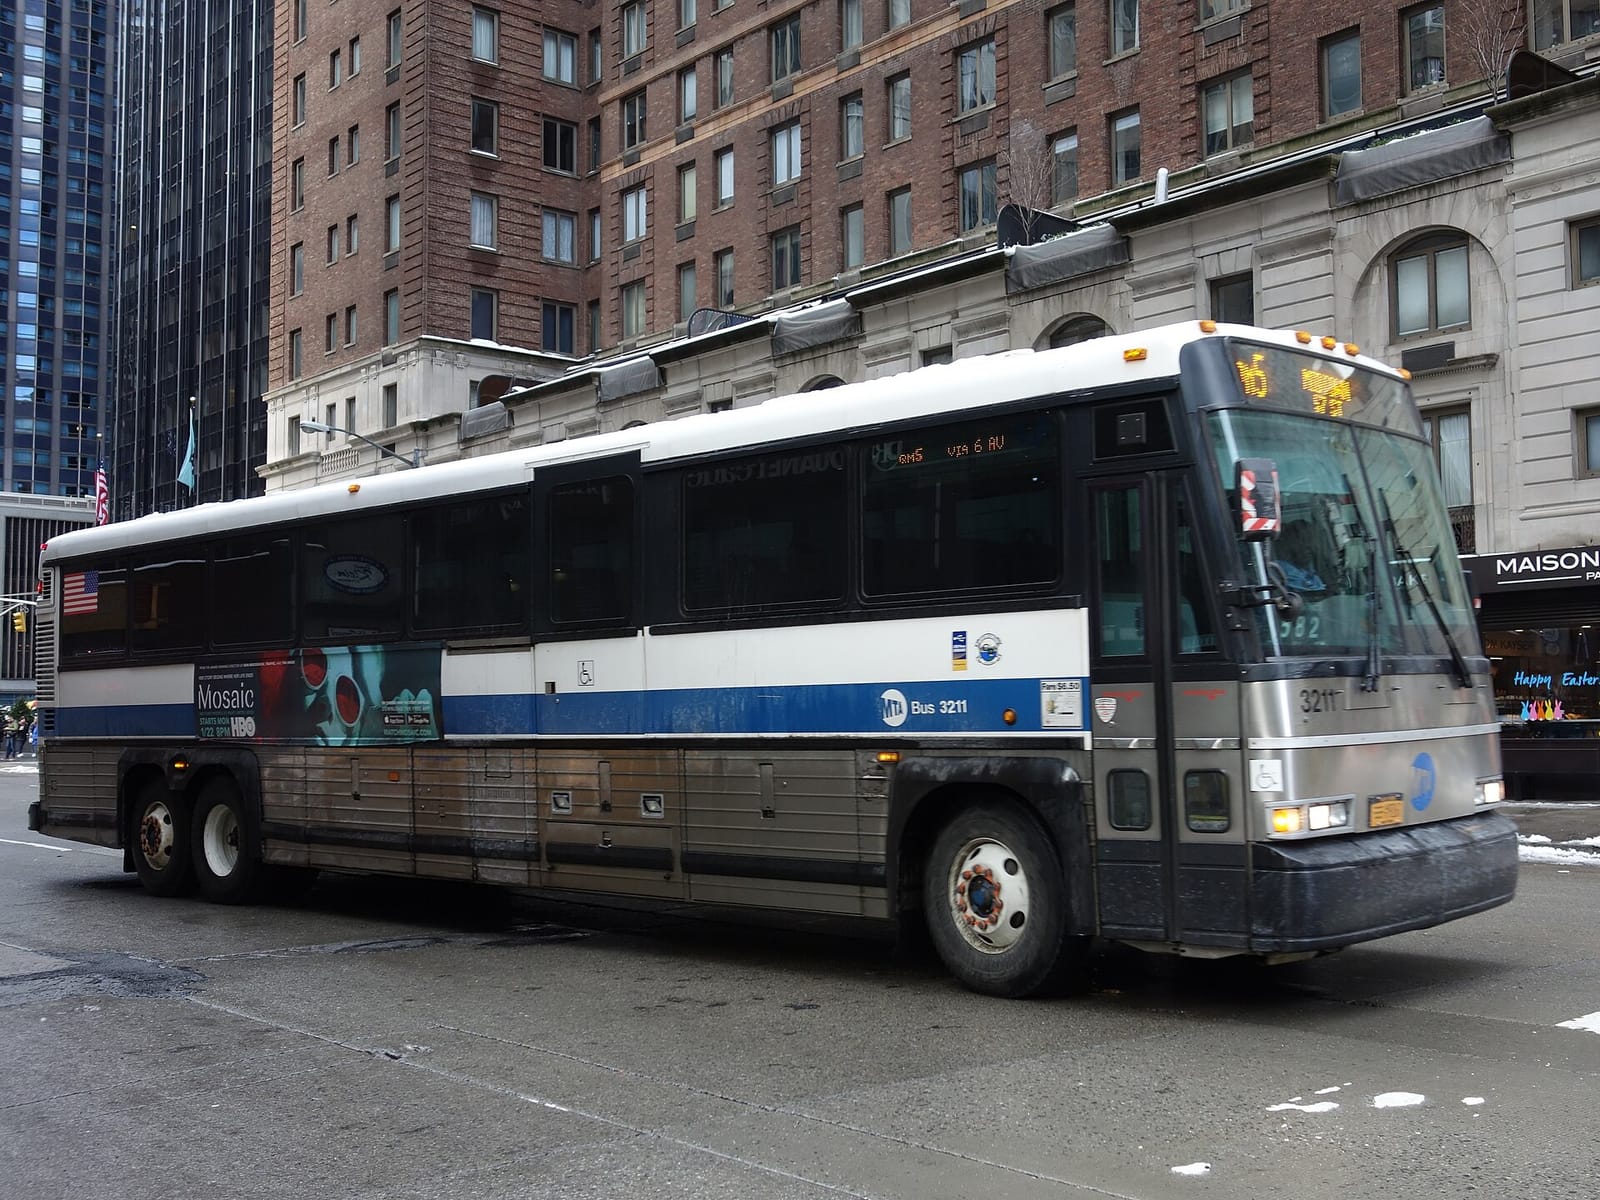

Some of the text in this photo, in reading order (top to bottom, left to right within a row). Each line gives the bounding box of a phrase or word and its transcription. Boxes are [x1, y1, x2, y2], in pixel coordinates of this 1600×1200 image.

[946, 444, 970, 458] VIA
[973, 439, 983, 453] 6
[987, 434, 1006, 451] AV
[1496, 551, 1600, 575] MAISON
[1513, 671, 1552, 690] Happy
[198, 681, 255, 710] Mosaic
[911, 699, 968, 715] Bus 3211
[1300, 689, 1336, 712] 3211
[881, 695, 905, 721] MTA
[200, 726, 231, 737] 1/22 8PM
[231, 716, 256, 737] HBO
